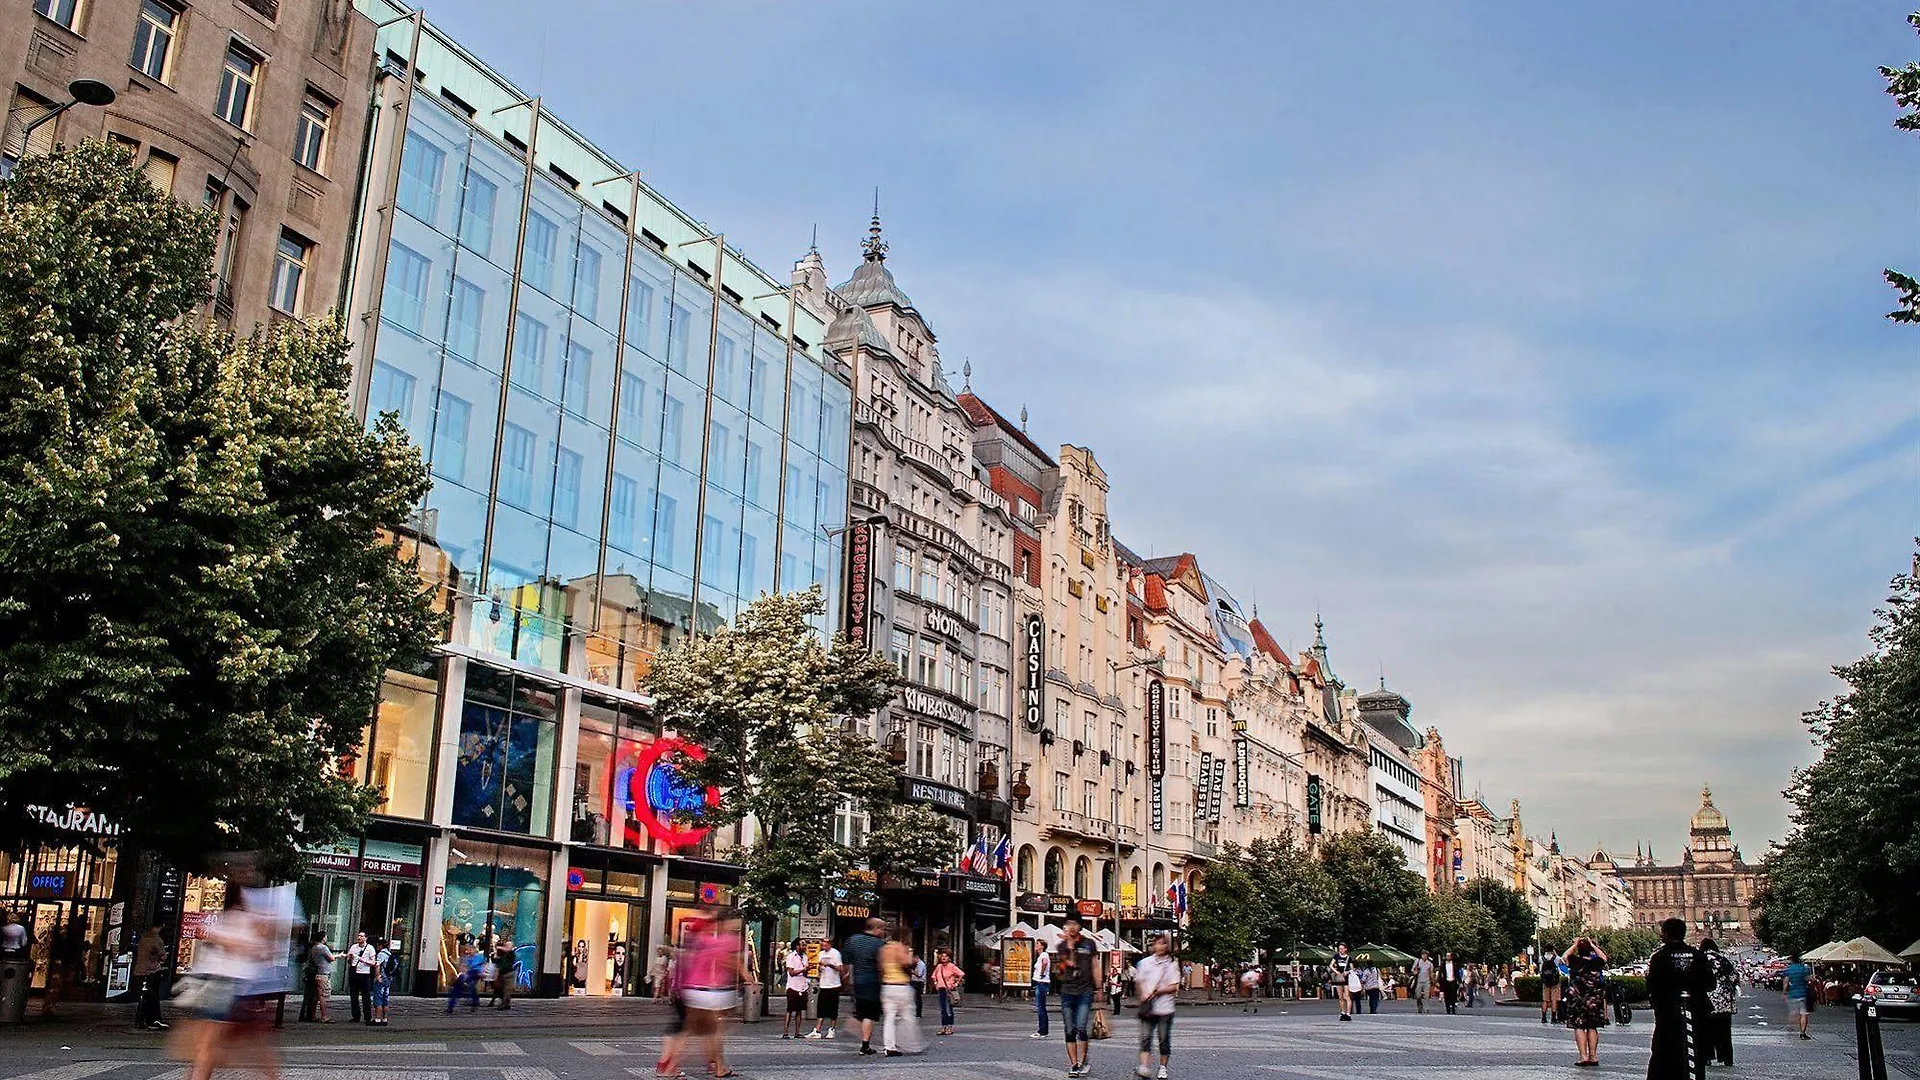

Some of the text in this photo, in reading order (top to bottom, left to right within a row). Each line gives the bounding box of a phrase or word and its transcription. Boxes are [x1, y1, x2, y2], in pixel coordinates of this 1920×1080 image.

[1027, 620, 1040, 723] CASINO
[1196, 754, 1211, 818] RESERVED
[1209, 761, 1224, 821] RESERVED
[1237, 741, 1247, 805] McDonald's
[1152, 778, 1163, 830] RESERVE
[1308, 782, 1320, 824] GATE
[32, 876, 66, 888] OFFICE
[363, 860, 402, 872] FOR RENT
[836, 905, 870, 918] CASINO
